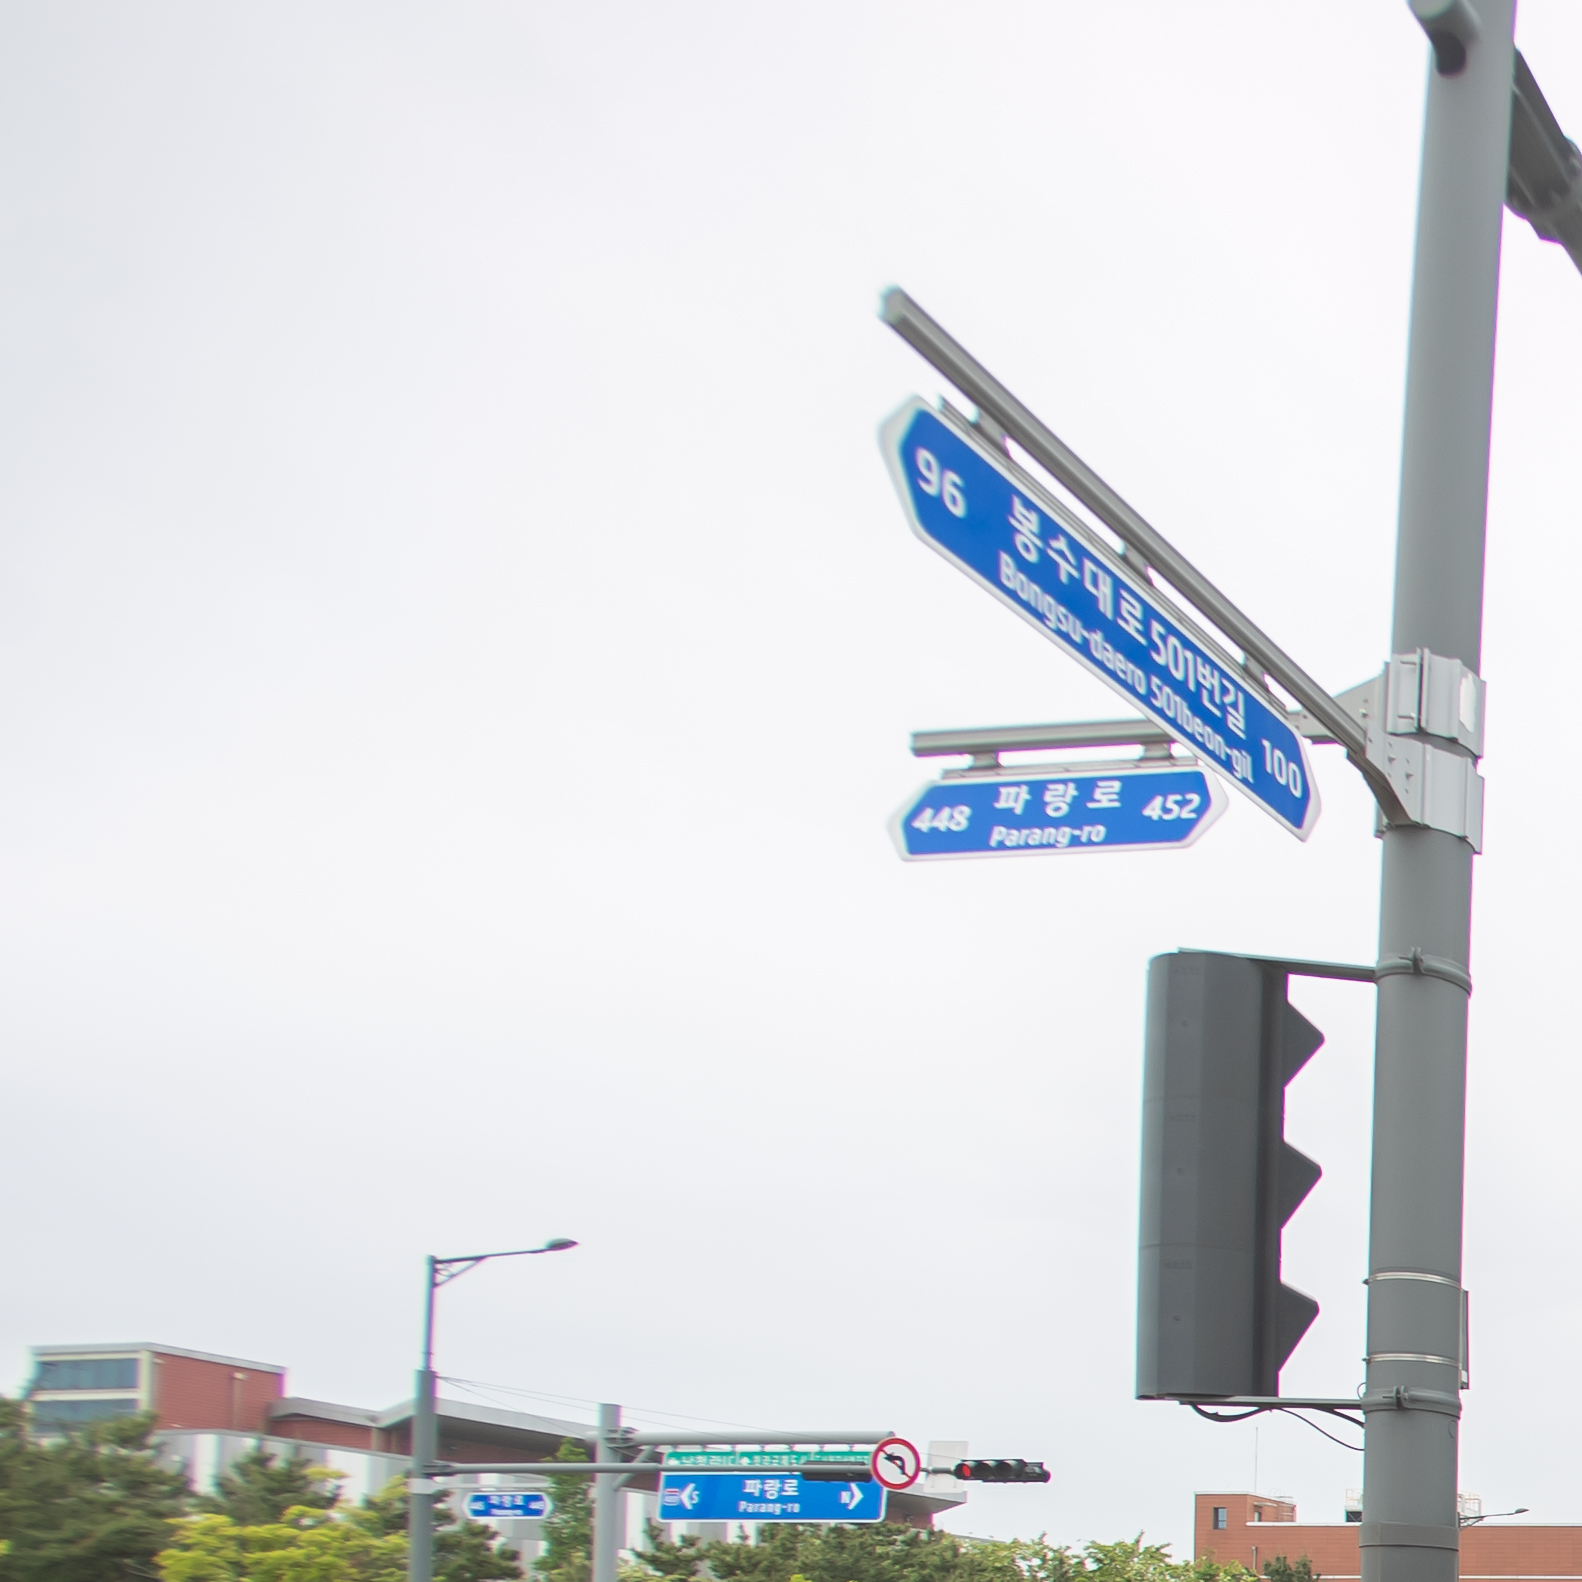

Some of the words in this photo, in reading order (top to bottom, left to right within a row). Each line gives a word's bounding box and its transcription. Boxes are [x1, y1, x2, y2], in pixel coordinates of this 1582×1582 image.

[914, 448, 967, 518] 96
[1009, 493, 1246, 741] 봉수대로501번길
[999, 552, 1147, 697] Bongsu-daero
[1149, 678, 1253, 784] 501beon-gil
[1262, 739, 1301, 799] 100
[993, 780, 1122, 818] 파랑로
[1141, 793, 1202, 821] 452
[912, 806, 973, 833] 448
[990, 823, 1106, 849] Parang-ro
[743, 1479, 799, 1500] 파랑로
